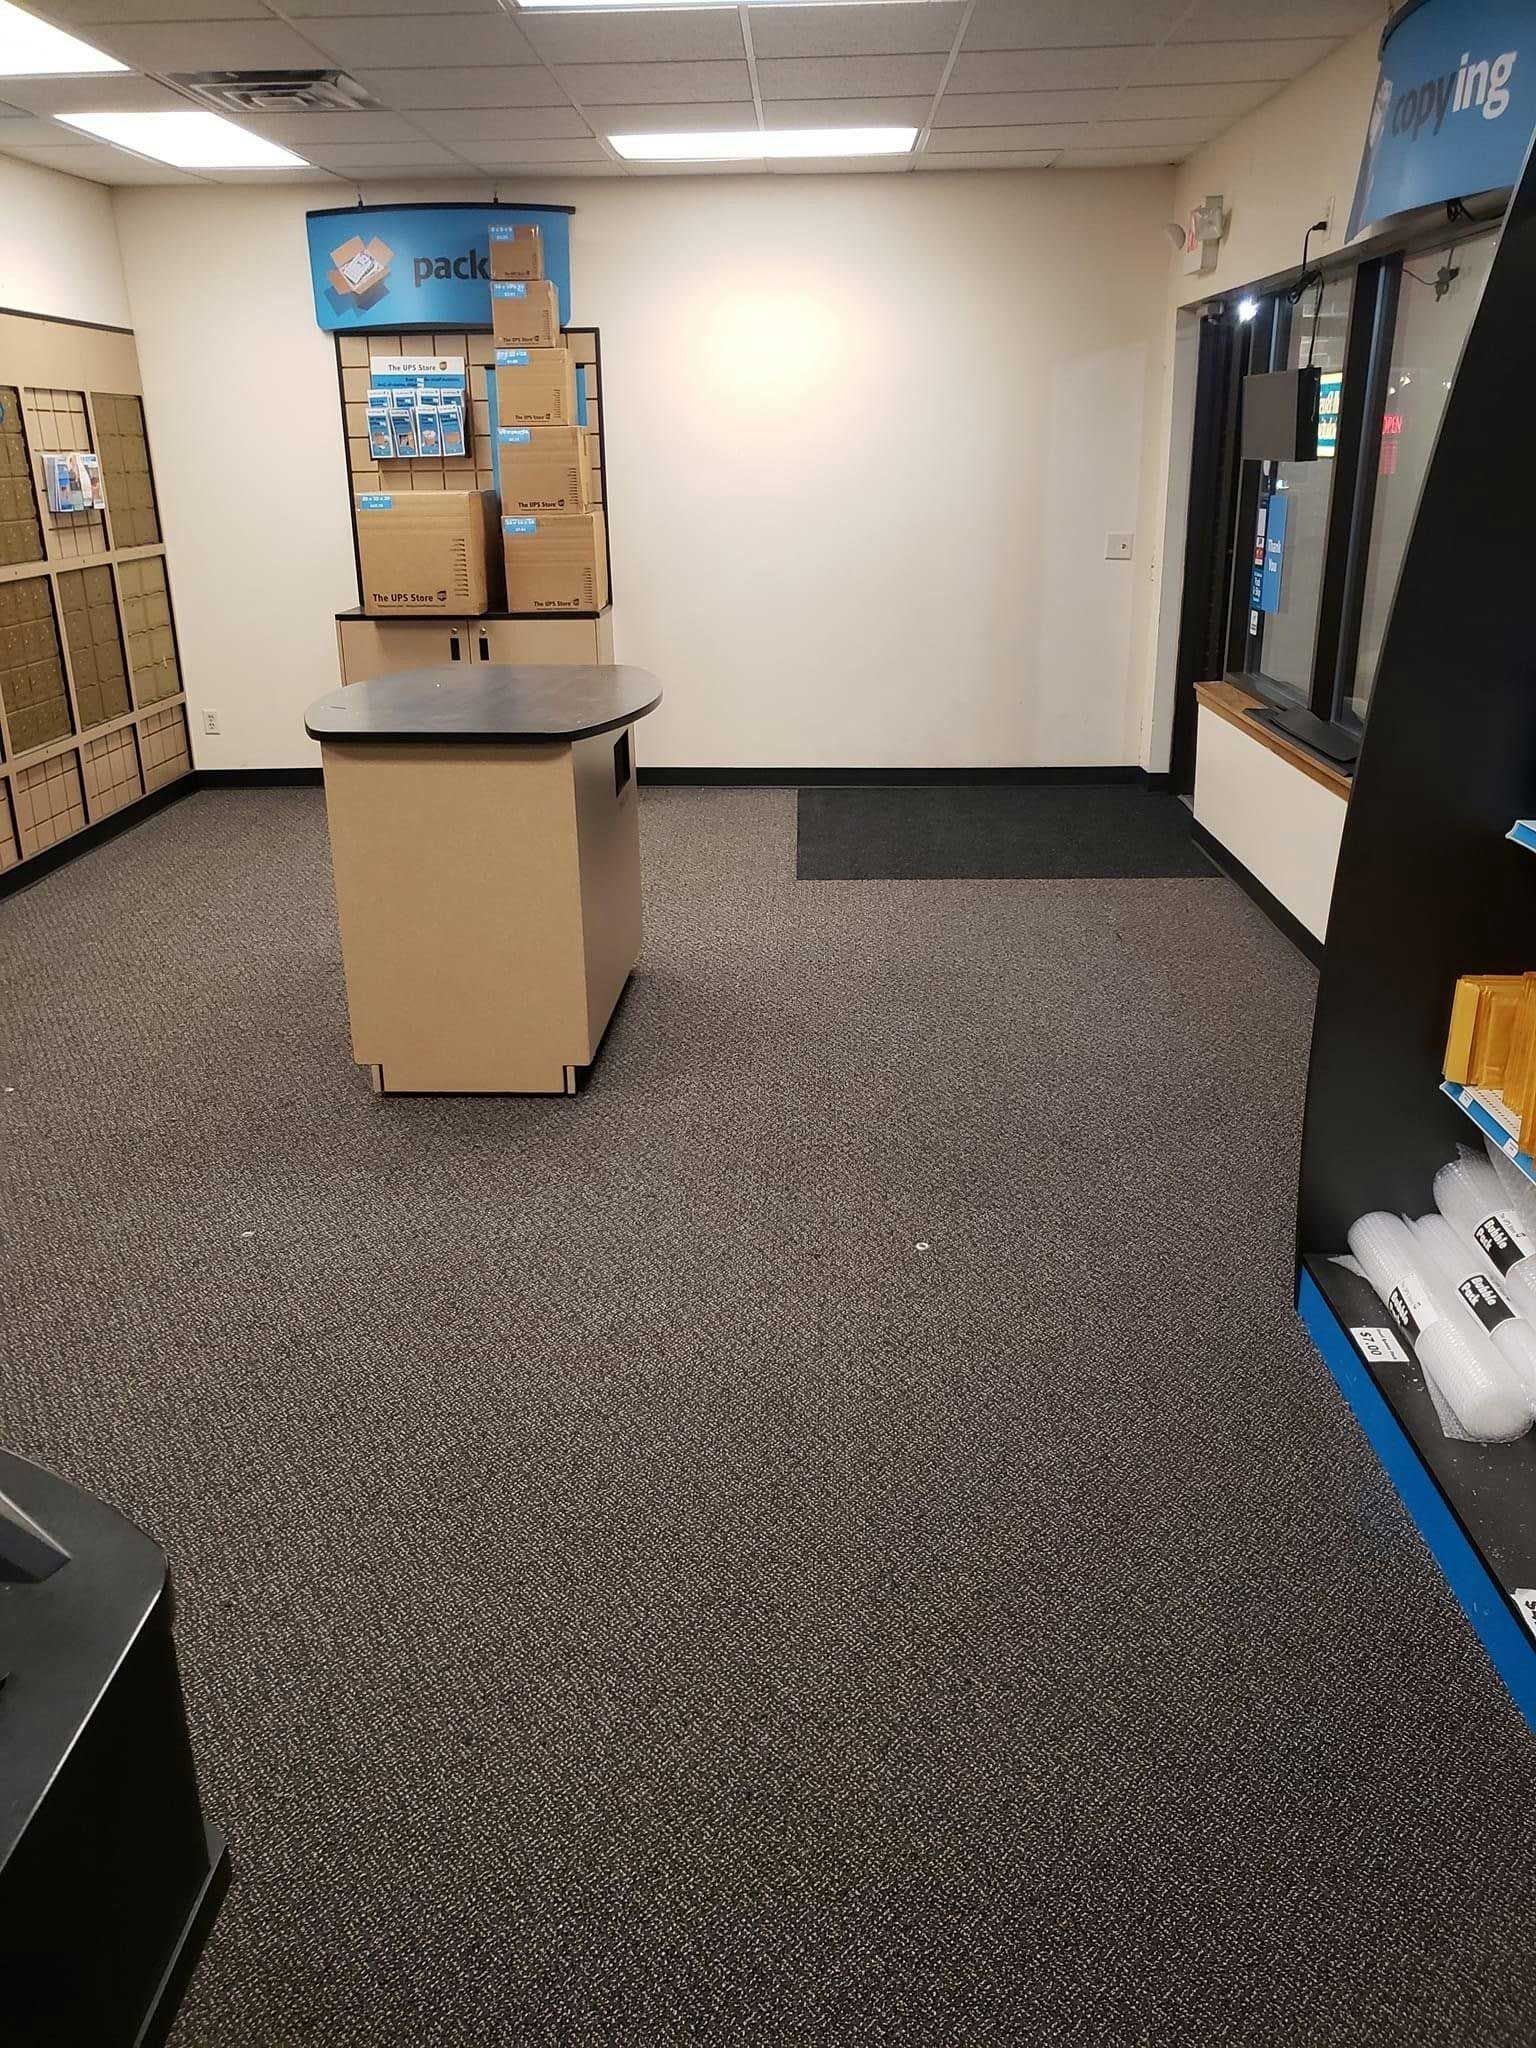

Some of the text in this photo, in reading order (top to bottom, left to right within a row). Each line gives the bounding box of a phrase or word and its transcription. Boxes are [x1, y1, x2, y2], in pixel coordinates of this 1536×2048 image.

[1391, 51, 1518, 142] copying
[413, 248, 491, 288] pack
[372, 594, 434, 602] The UPS Store
[1475, 1227, 1493, 1252] Pack
[1483, 1220, 1508, 1250] Bubble
[1461, 1283, 1480, 1307] Pack
[1471, 1276, 1497, 1307] Bubble
[1391, 1289, 1409, 1325] Bubble
[1359, 1330, 1382, 1356] $7.00
